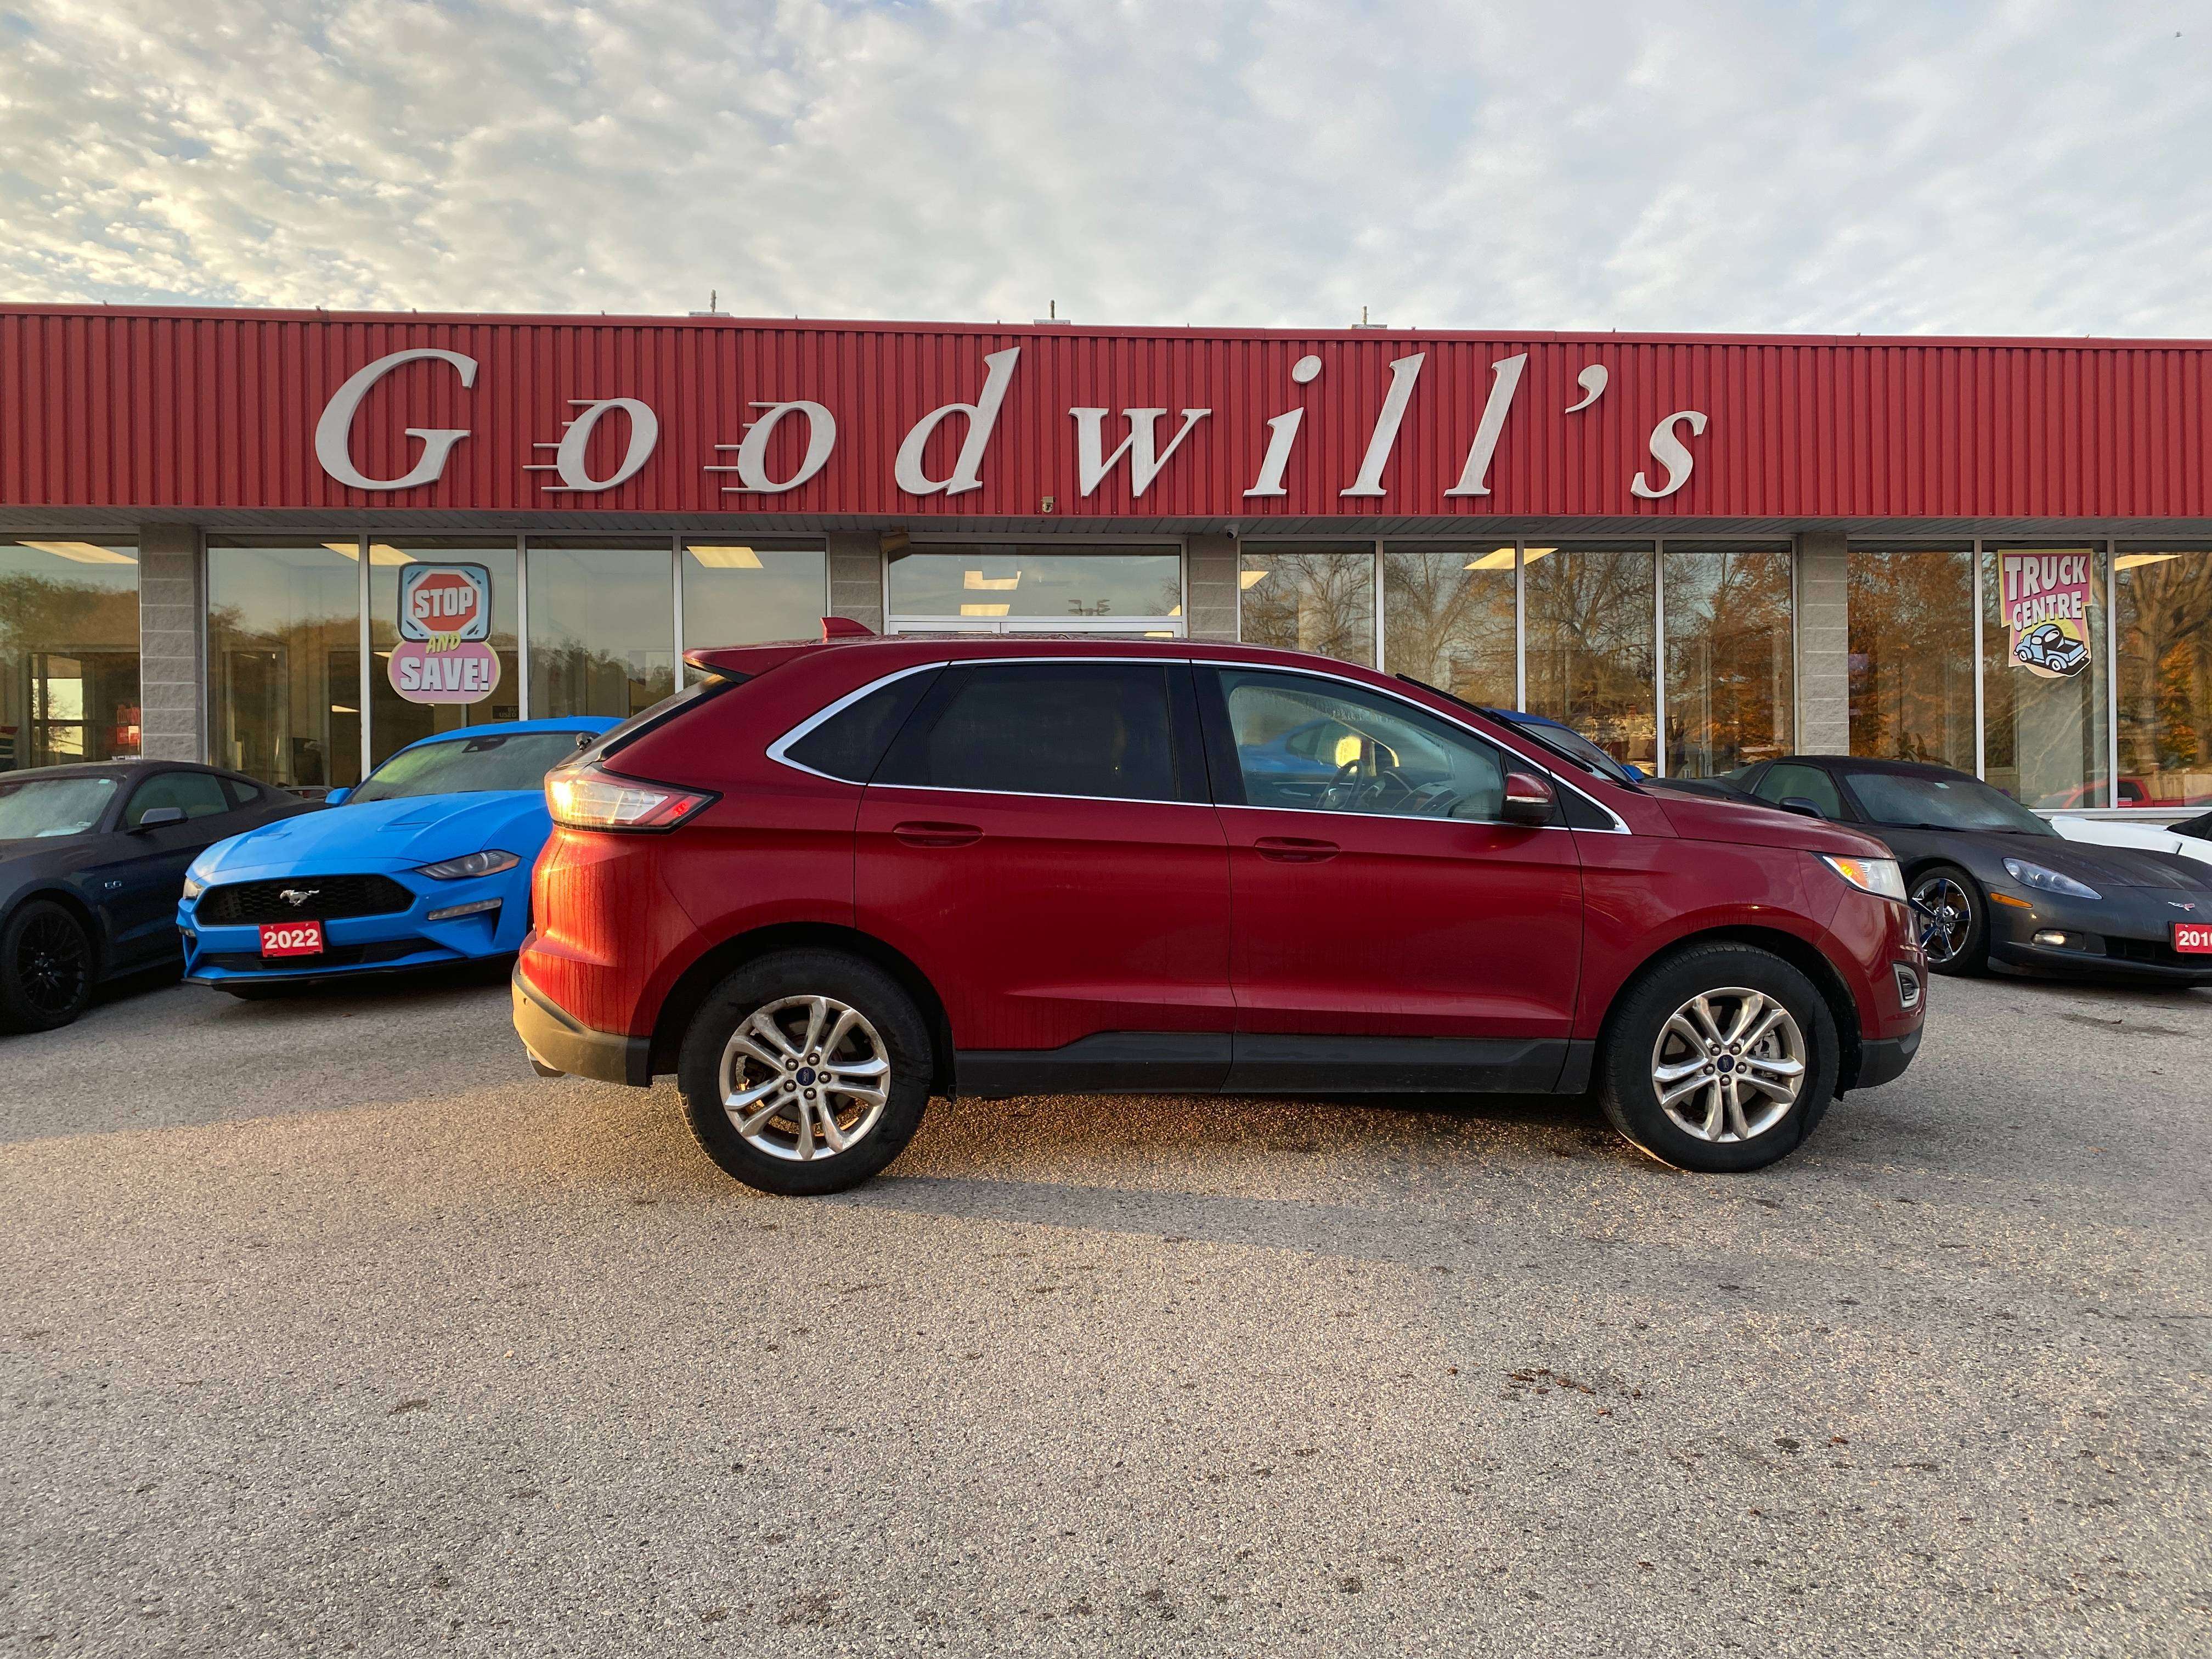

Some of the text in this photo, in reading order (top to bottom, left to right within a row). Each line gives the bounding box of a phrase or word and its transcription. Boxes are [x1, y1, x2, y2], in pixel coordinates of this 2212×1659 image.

[315, 347, 1707, 498] Goodwill's
[2005, 556, 2086, 601] TRUCK
[415, 587, 473, 618] STOP
[2012, 591, 2083, 631] CENTRE
[426, 632, 461, 654] AND
[400, 657, 489, 691] SAVE!
[264, 928, 319, 949] 2022
[2179, 930, 2212, 947] 201
